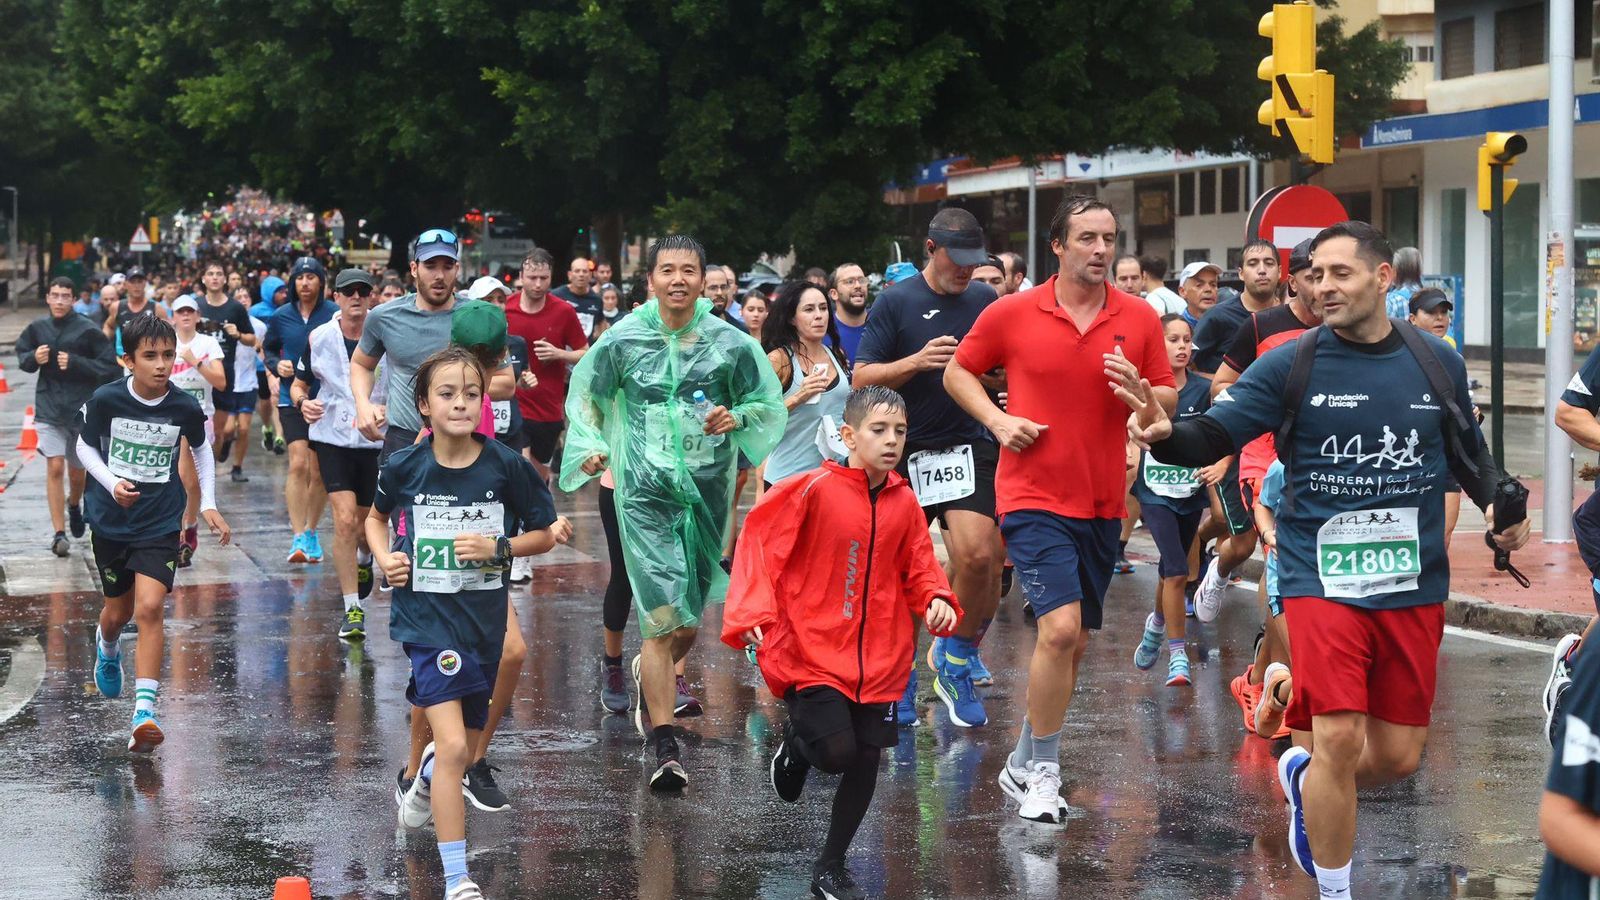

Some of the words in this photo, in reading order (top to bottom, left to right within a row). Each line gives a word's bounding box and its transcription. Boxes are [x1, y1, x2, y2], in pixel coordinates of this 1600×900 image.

[1328, 393, 1369, 401] Fundación
[1328, 400, 1358, 408] Unicaja
[659, 434, 704, 451] 167
[114, 443, 168, 466] 21556
[922, 466, 965, 486] 7458
[1310, 472, 1374, 485] CARRERA
[1310, 483, 1373, 496] URBANA
[1326, 547, 1413, 575] 21803
[842, 539, 860, 620] BTWIN
